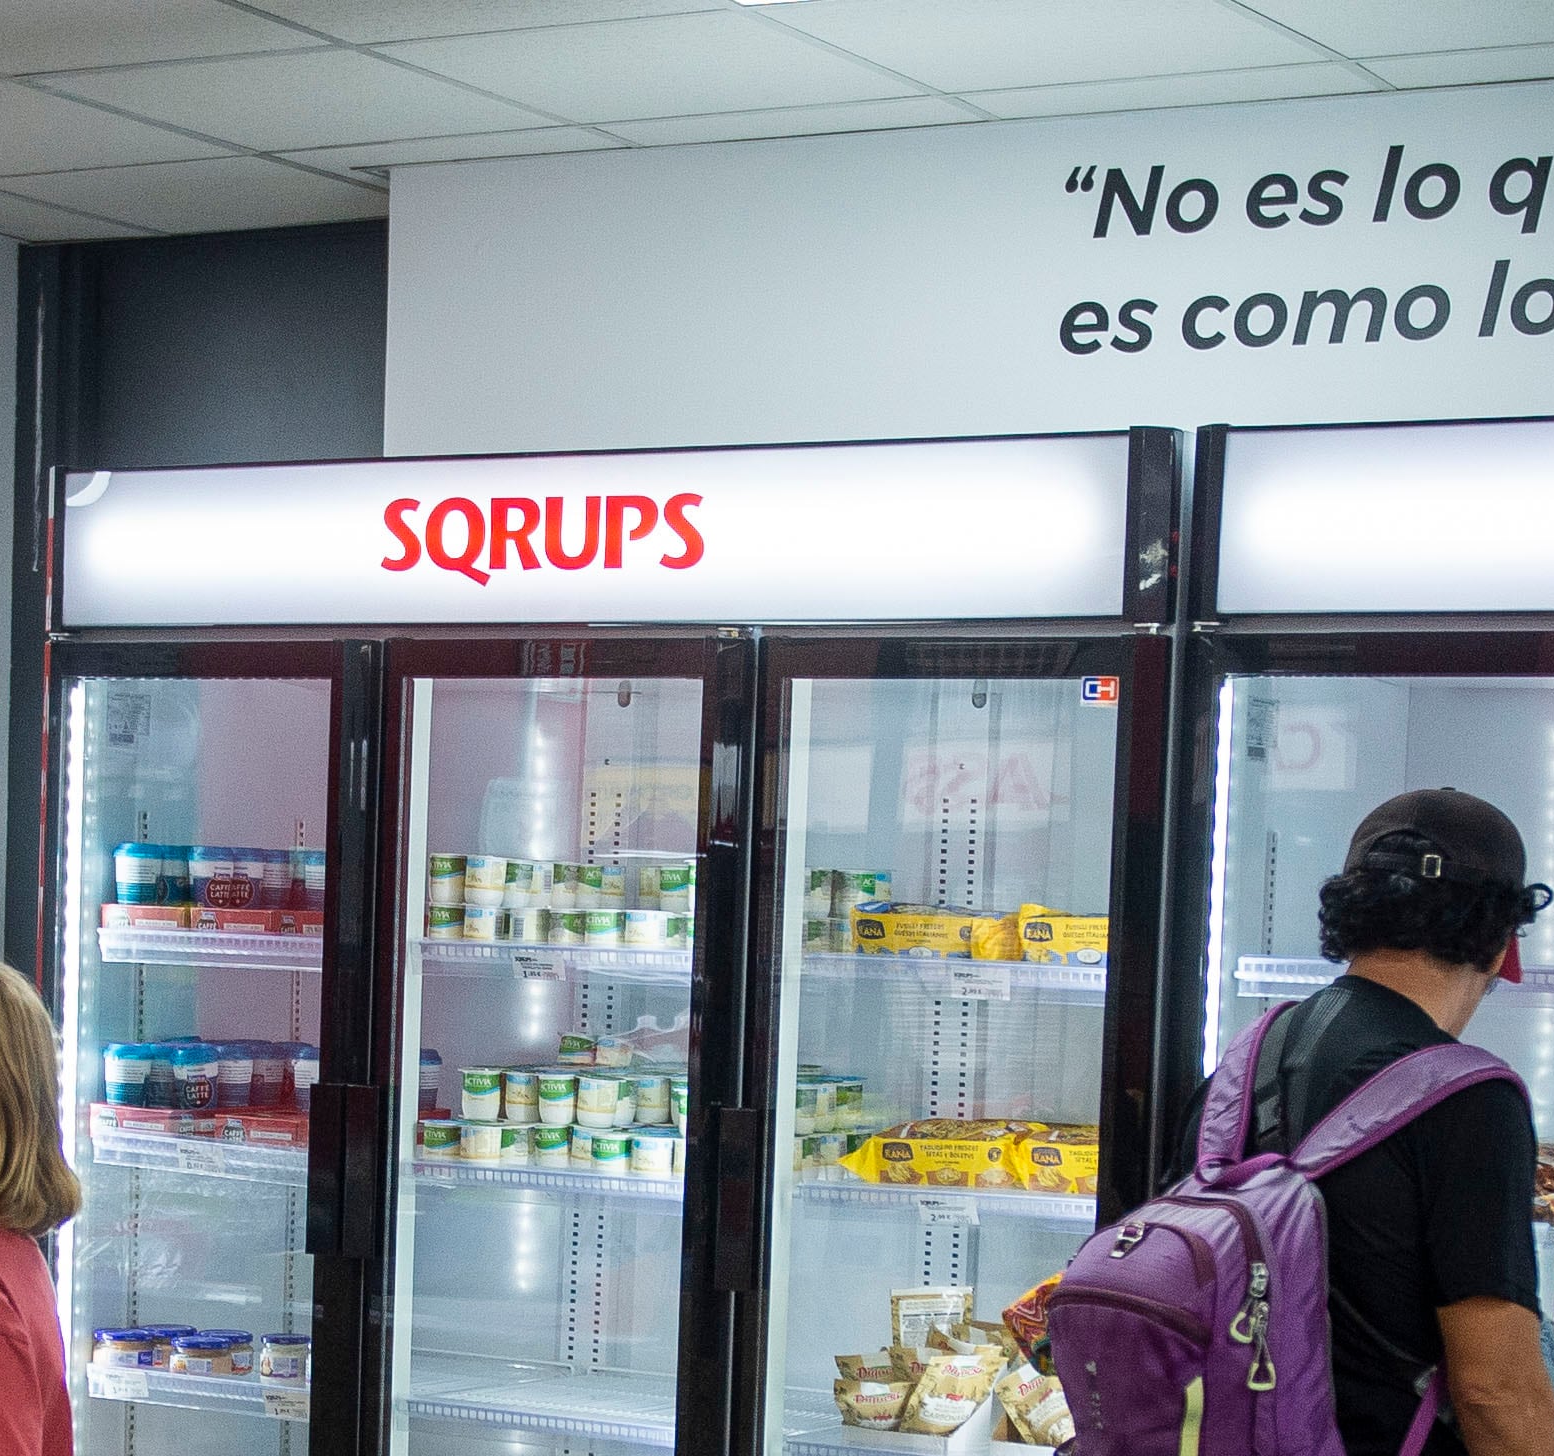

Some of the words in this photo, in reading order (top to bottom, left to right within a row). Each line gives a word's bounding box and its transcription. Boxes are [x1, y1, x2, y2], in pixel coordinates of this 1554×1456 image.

[1245, 169, 1351, 229] es
[1372, 144, 1461, 222] lo
[1059, 298, 1158, 355] es
[1181, 284, 1451, 350] como
[381, 493, 705, 587] SQRUPS
